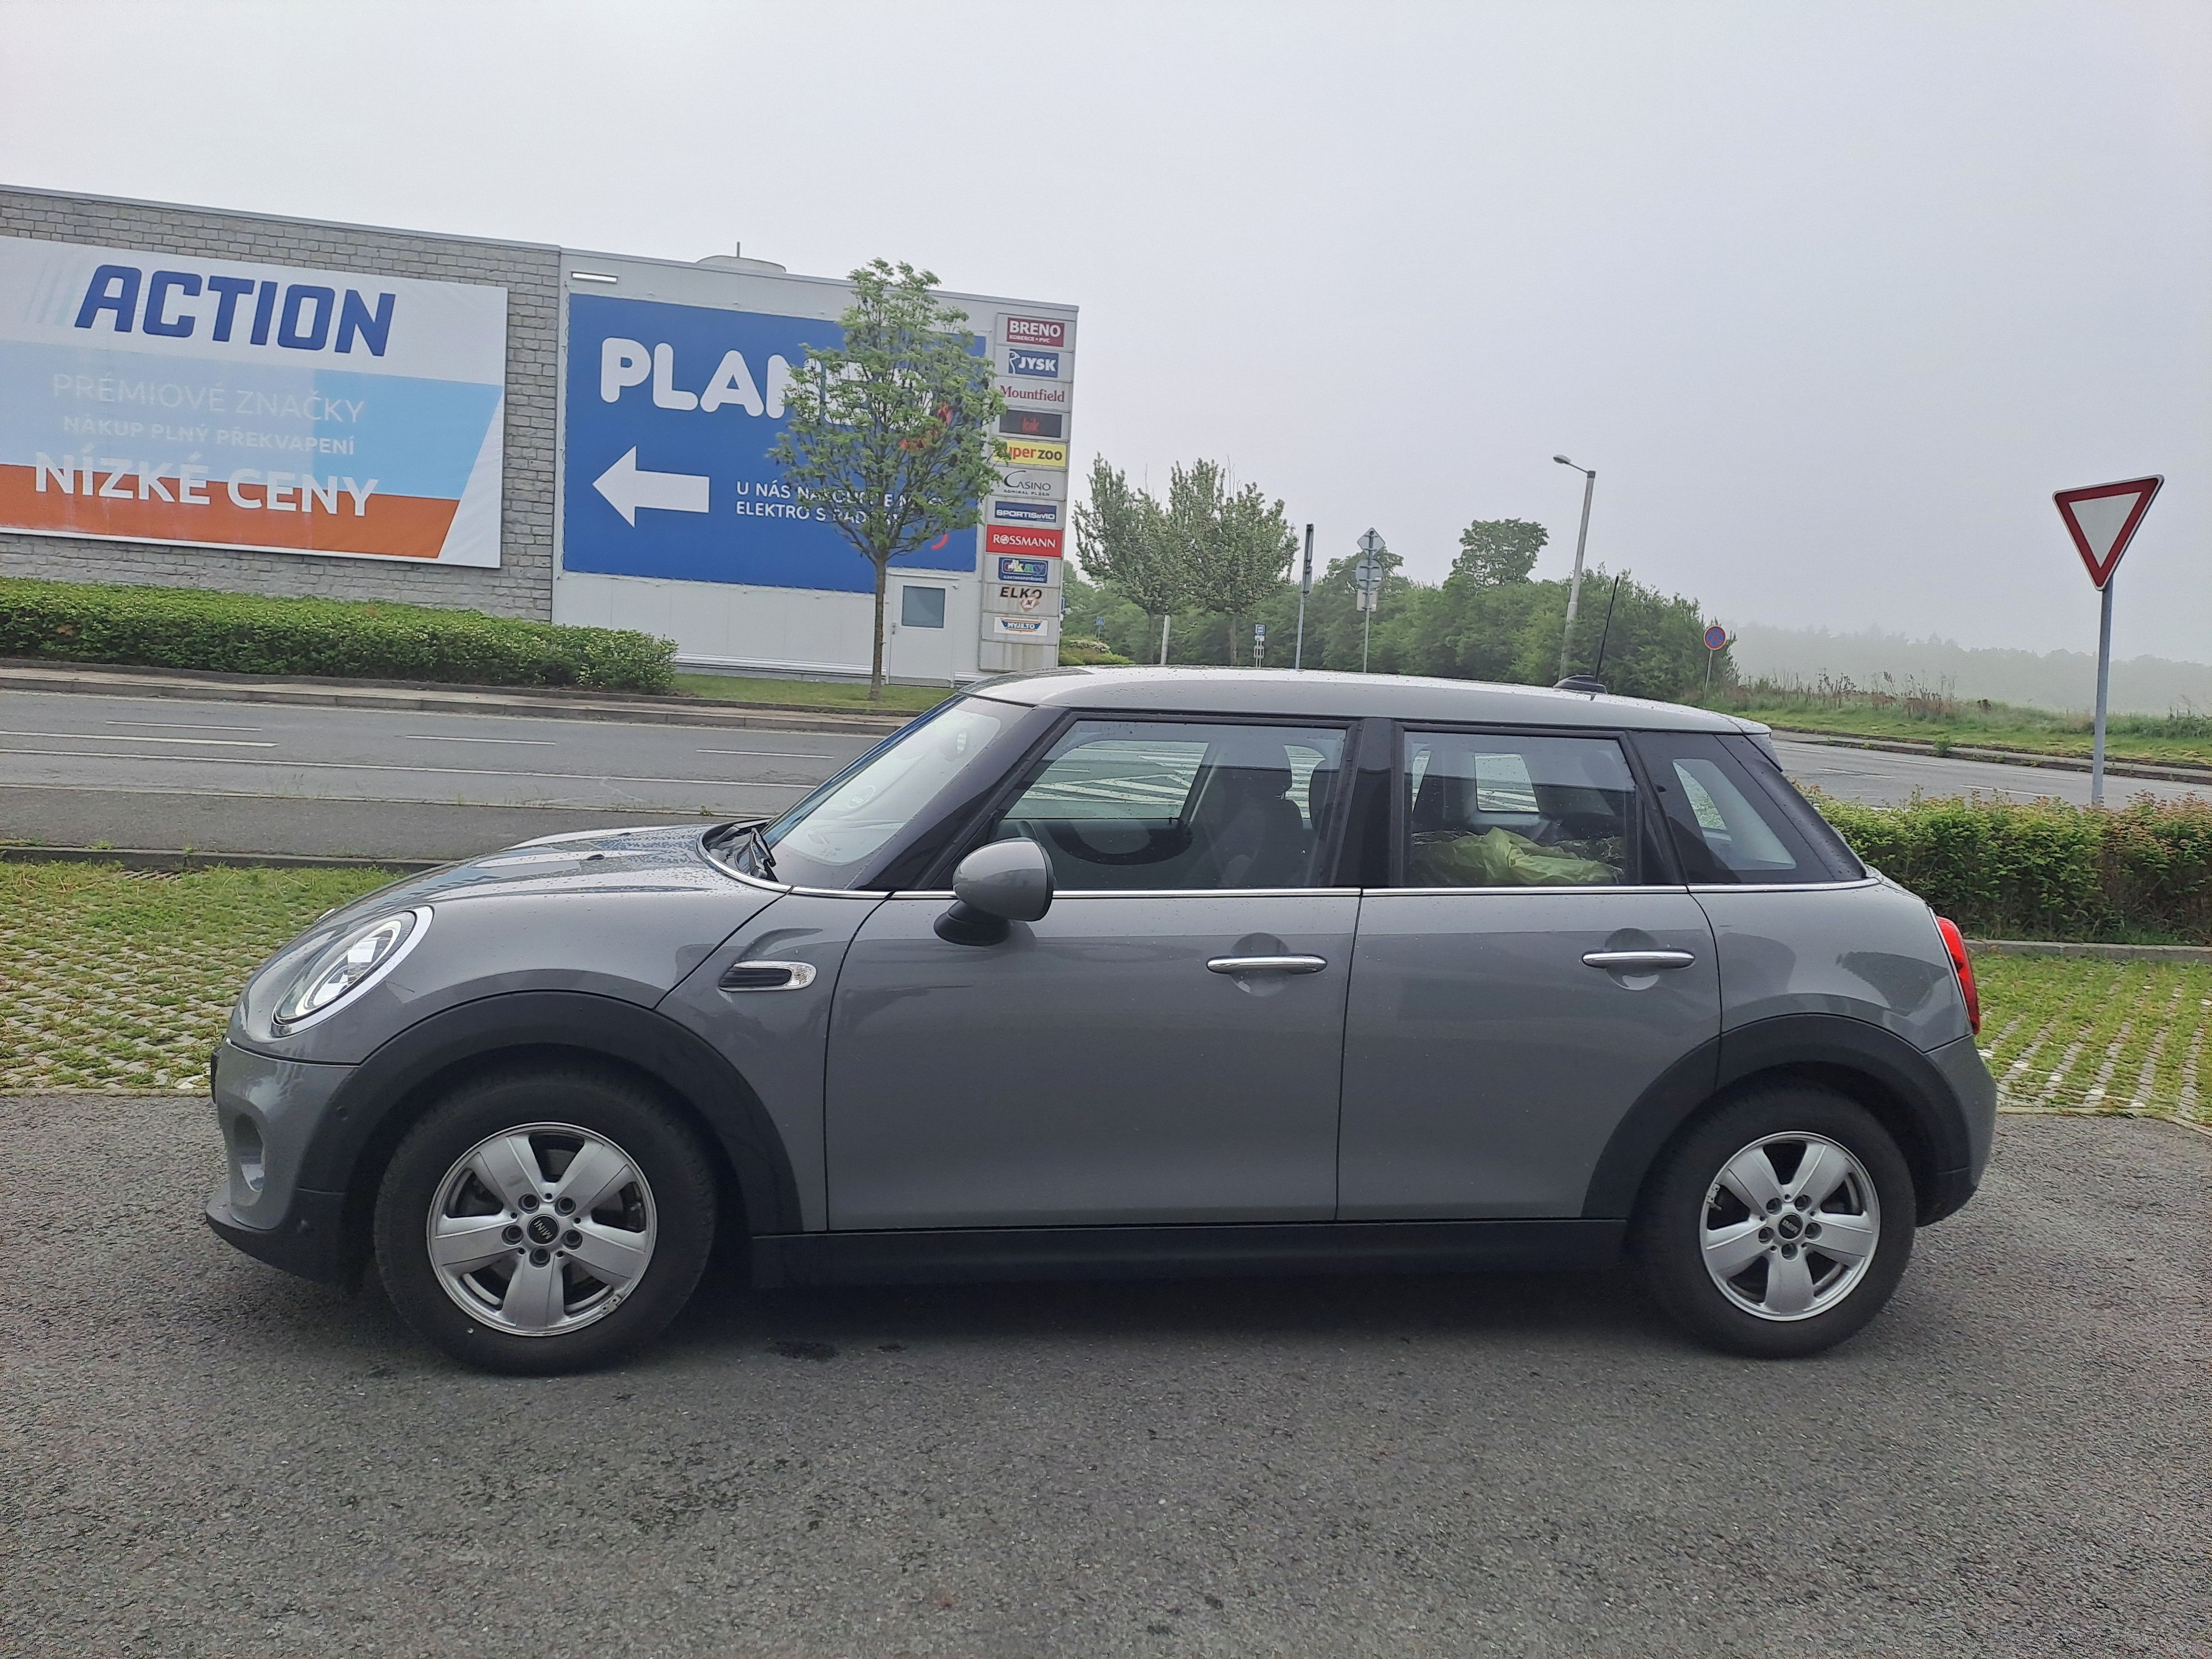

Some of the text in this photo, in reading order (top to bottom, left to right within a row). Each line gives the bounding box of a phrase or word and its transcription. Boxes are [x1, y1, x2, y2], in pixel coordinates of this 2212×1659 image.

[74, 264, 395, 357] ACTION
[1009, 320, 1061, 337] BRENO
[1018, 356, 1057, 373] JYSK
[54, 373, 364, 424] PRÉMIOVÉ ZNAČKY
[1000, 385, 1065, 403] Mountfield
[63, 413, 355, 456] NÁKUP PLNÝ PŘEKVAPENÍ
[1037, 449, 1063, 461] zoo
[35, 442, 379, 517] NÍZKÉ CENY
[736, 481, 750, 495] U
[755, 479, 791, 499] NÁS
[736, 500, 810, 520] ELEKTRO
[815, 507, 827, 522] S
[993, 534, 1056, 548] ROSSMANN
[1000, 587, 1042, 599] ELKO
[534, 1219, 553, 1239] MINI
